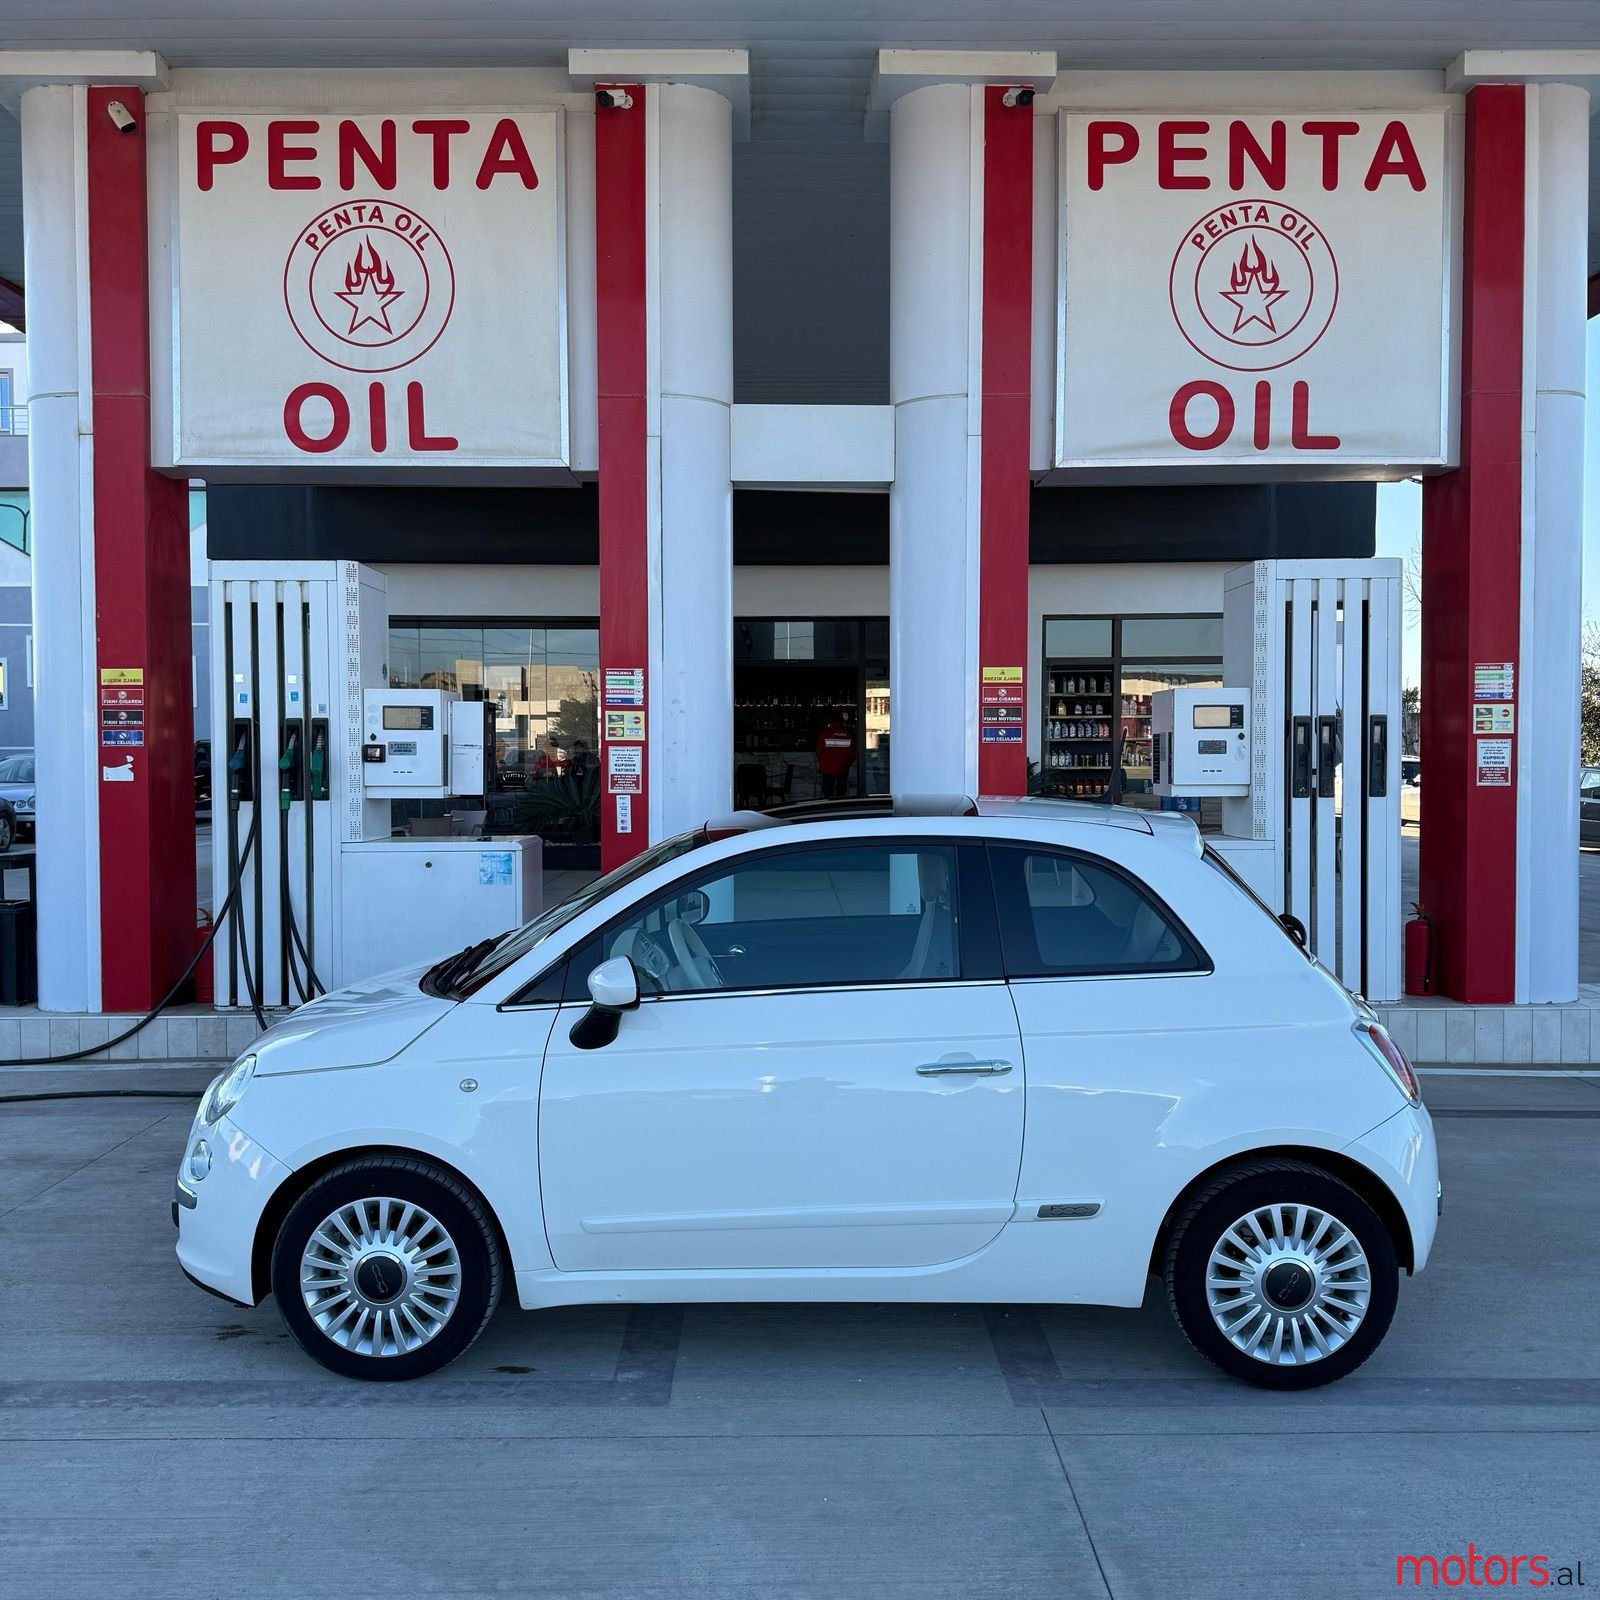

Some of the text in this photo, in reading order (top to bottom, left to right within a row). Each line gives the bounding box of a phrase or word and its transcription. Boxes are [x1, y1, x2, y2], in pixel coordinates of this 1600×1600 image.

[197, 119, 538, 191] PENTA
[1087, 120, 1427, 192] PENTA
[305, 205, 430, 251] PENTA OIL
[1191, 205, 1315, 251] PENTA OIL
[284, 381, 459, 453] OIL
[1169, 380, 1341, 450] OIL
